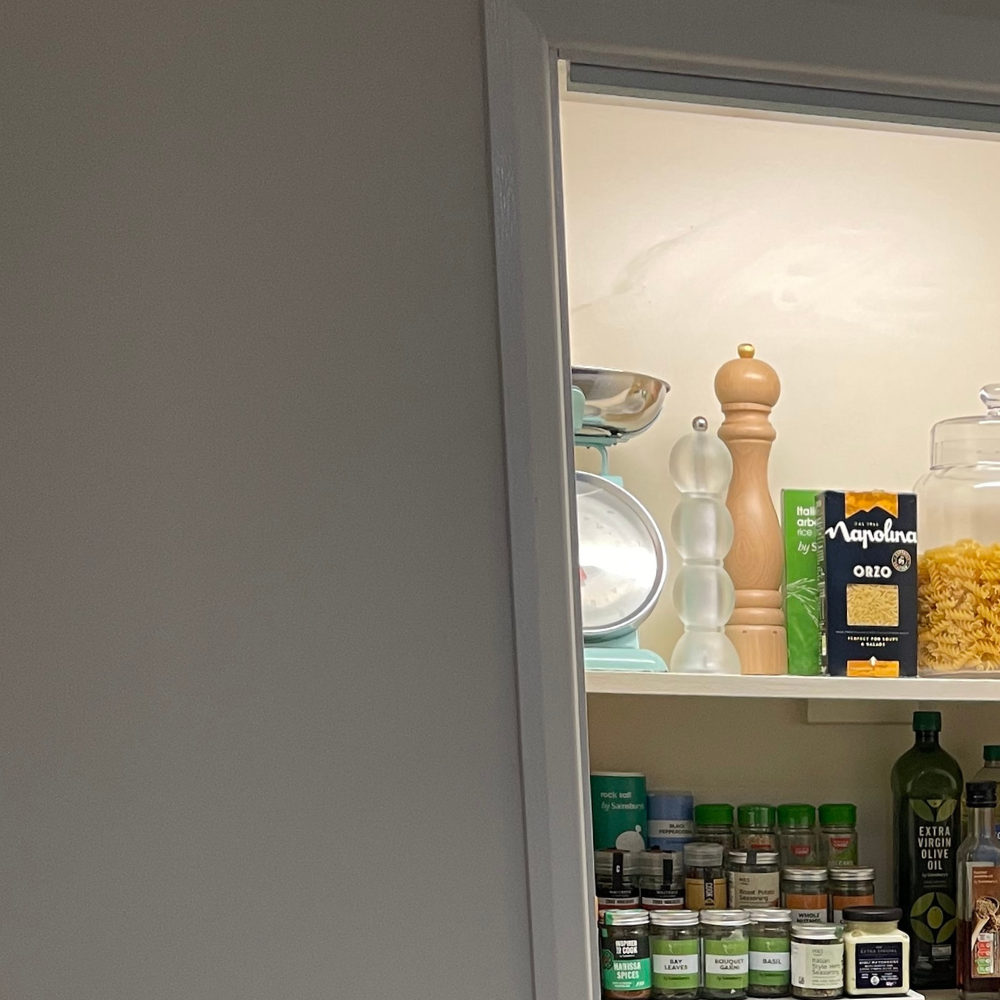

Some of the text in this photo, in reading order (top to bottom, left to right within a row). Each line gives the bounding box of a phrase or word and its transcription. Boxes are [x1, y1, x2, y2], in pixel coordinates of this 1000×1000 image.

[797, 529, 813, 537] rice
[825, 518, 918, 550] Napolina
[797, 541, 810, 555] by
[853, 565, 893, 579] ORZO
[600, 791, 617, 799] rock
[601, 801, 611, 811] by
[918, 826, 951, 837] EXTRA
[917, 837, 952, 848] VIRGIN
[921, 848, 949, 860] OLIVE
[927, 860, 943, 871] OIL
[622, 946, 638, 954] COOK
[613, 962, 642, 971] HARISSA
[811, 963, 828, 971] Style
[616, 970, 640, 980] SPICES
